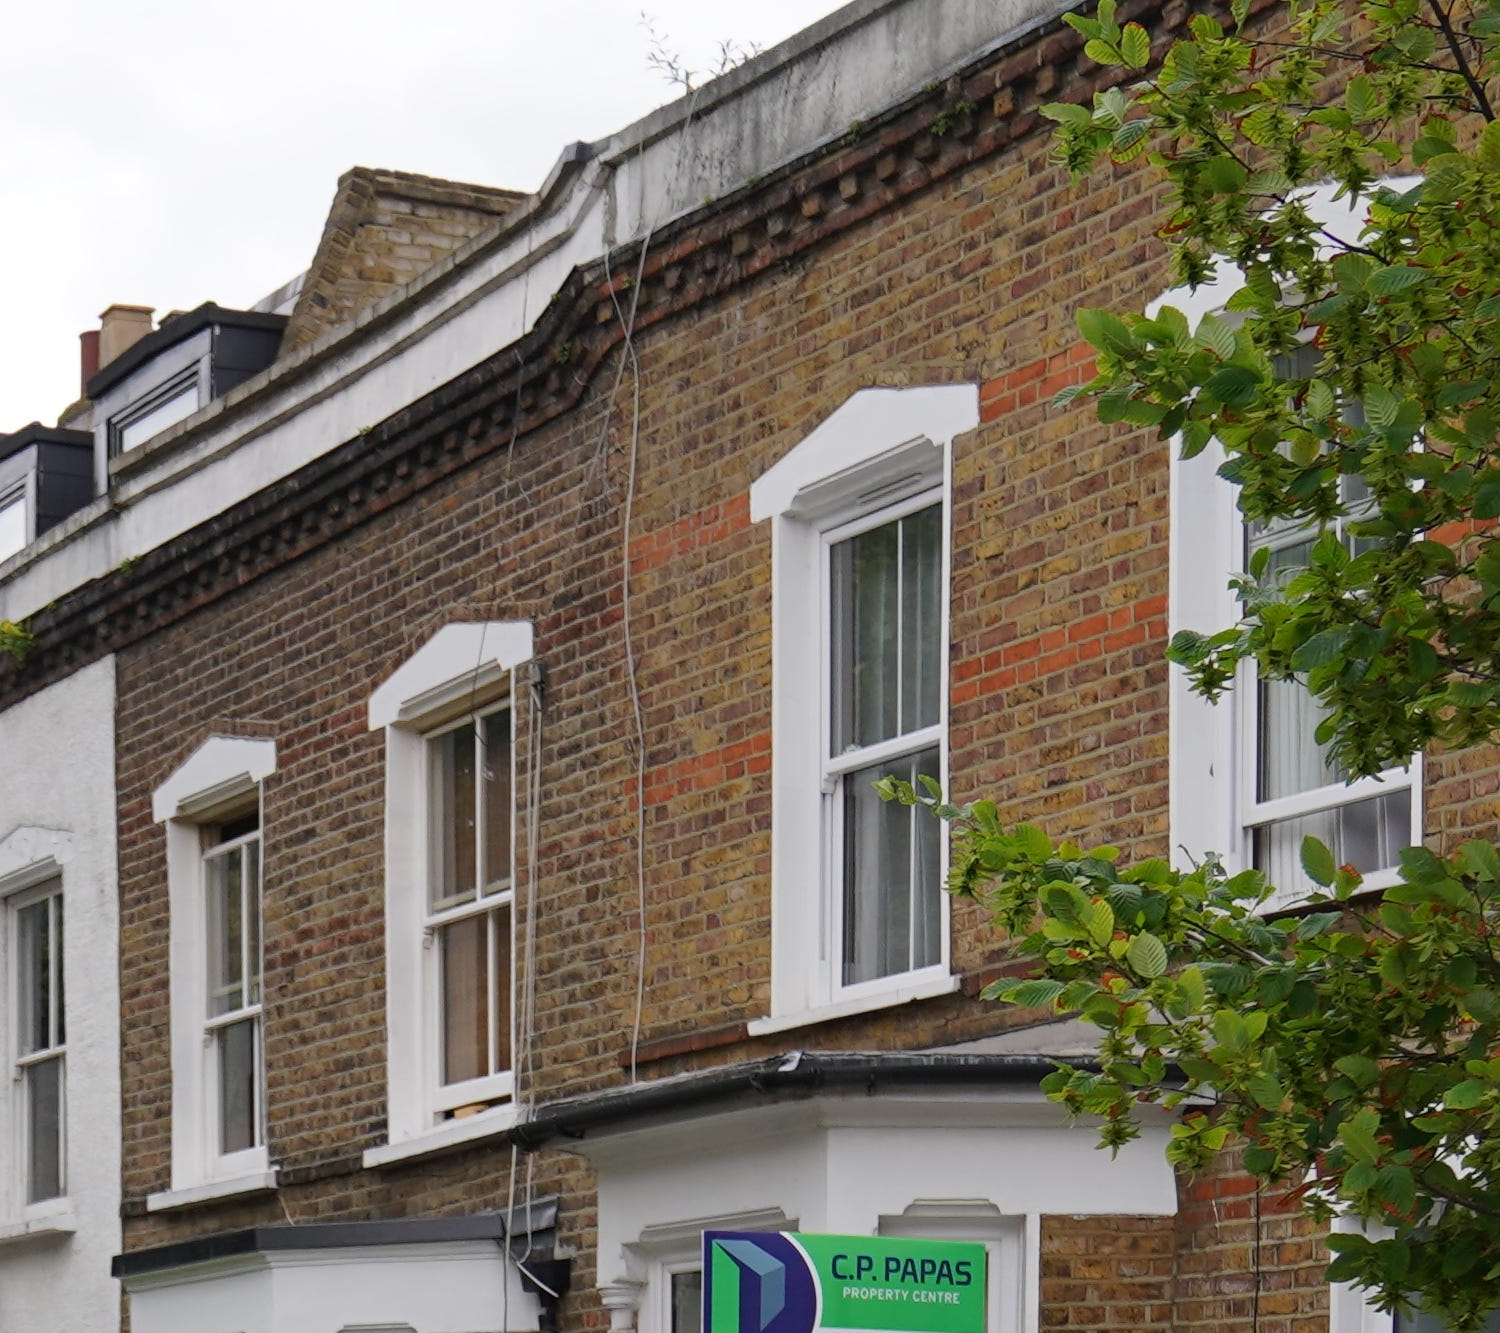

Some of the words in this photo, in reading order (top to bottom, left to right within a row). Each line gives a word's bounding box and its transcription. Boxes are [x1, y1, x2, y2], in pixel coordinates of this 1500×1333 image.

[832, 1254, 877, 1282] C.P.
[884, 1257, 972, 1286] PAPAS
[843, 1287, 909, 1301] PROPERTY
[912, 1290, 960, 1304] CENTRE
